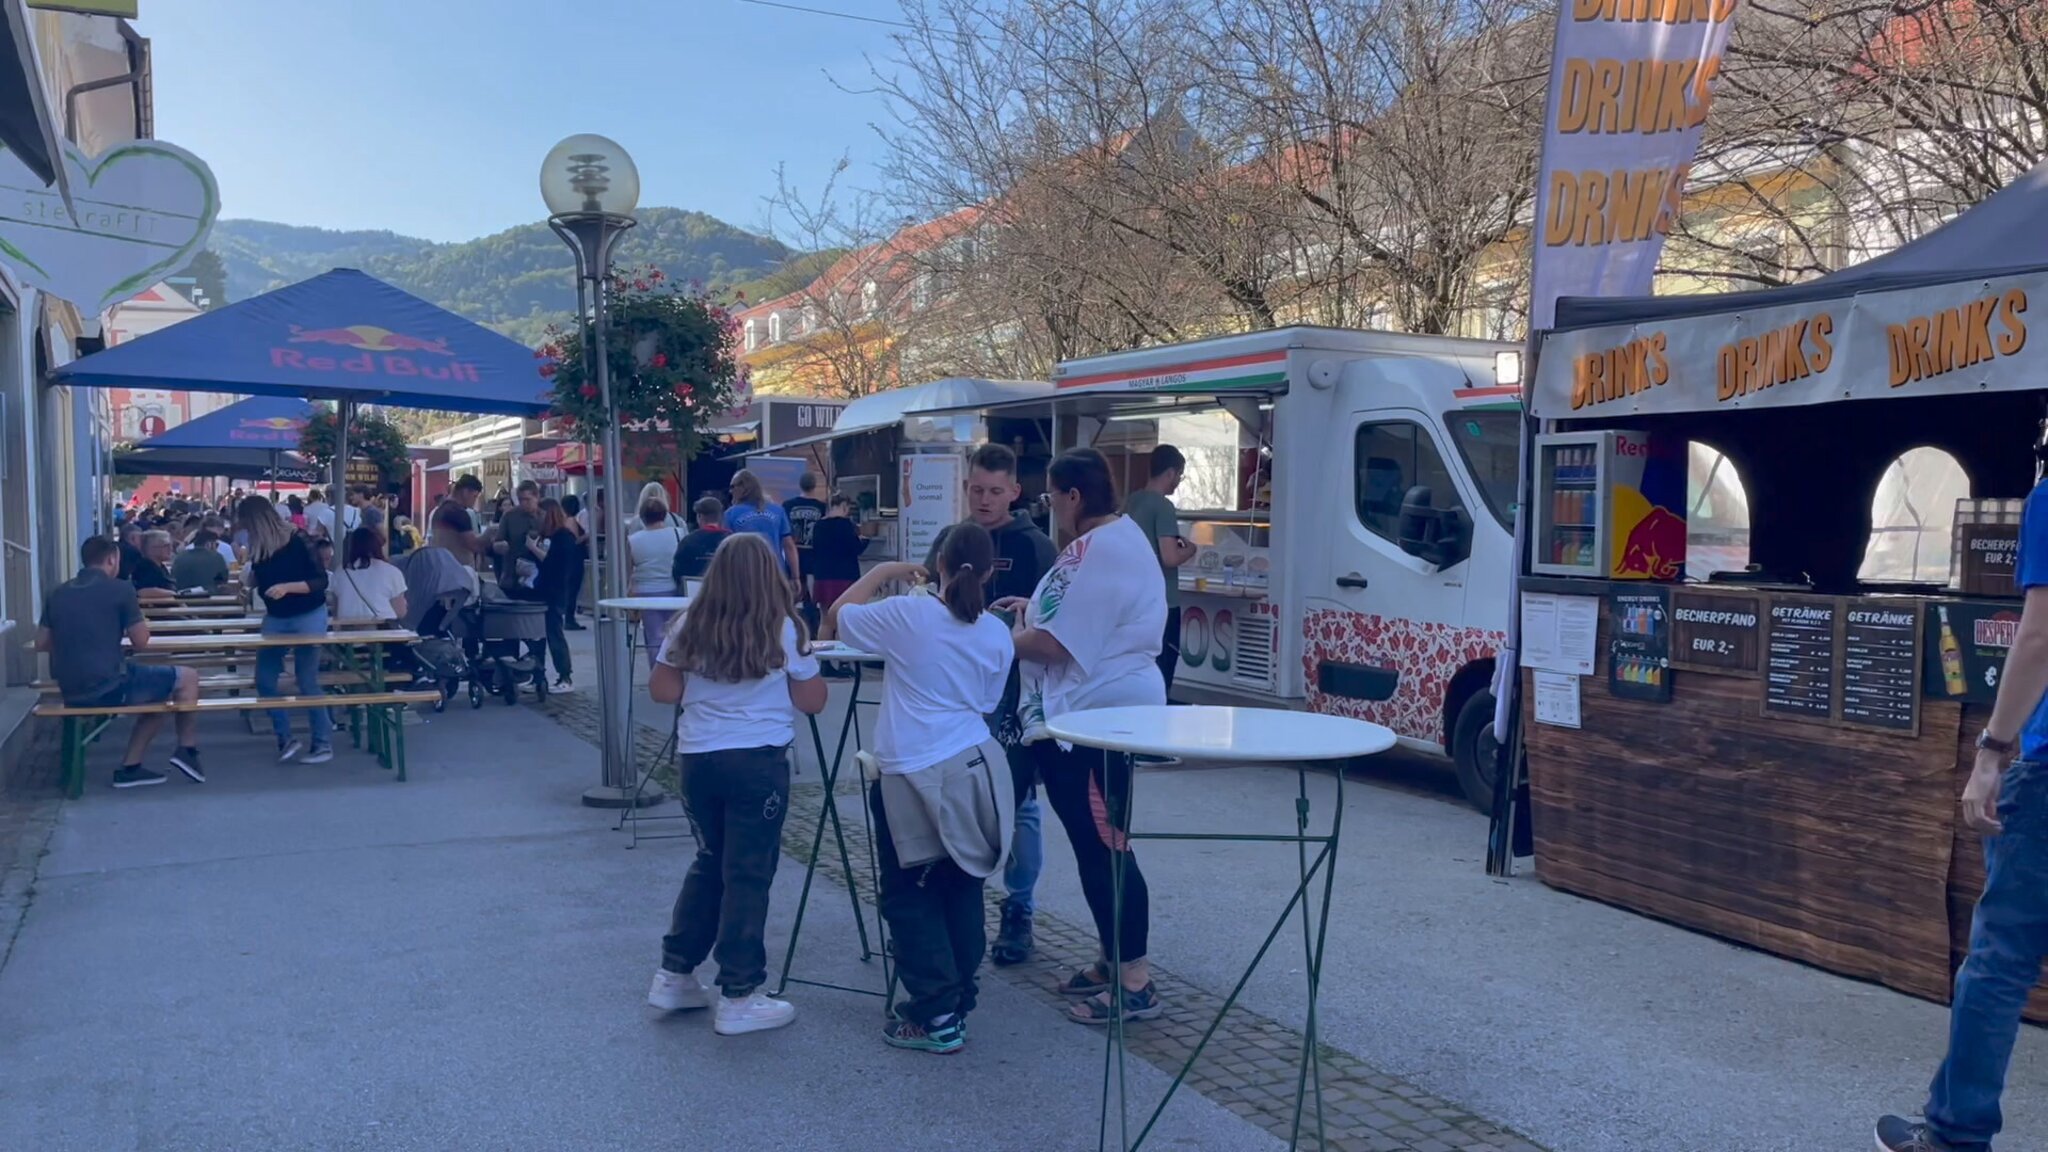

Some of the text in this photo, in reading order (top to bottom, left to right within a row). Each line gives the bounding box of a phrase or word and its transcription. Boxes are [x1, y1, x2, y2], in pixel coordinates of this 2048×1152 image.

[22, 200, 158, 233] steraFIT
[1716, 313, 1833, 401] DRINKS
[1886, 288, 2028, 388] DRINKS
[271, 348, 480, 383] Red Bull
[1128, 376, 1154, 388] MAGYAR
[797, 405, 812, 428] GO
[916, 483, 943, 491] Churros
[1985, 552, 2003, 564] EUR
[1675, 608, 1756, 627] BECHERPFAND
[1772, 606, 1832, 621] GETRÄNKE
[1848, 611, 1914, 626] GETRÄNKE
[1692, 638, 1735, 655] EUR 2,-
[1984, 666, 1998, 687] €
